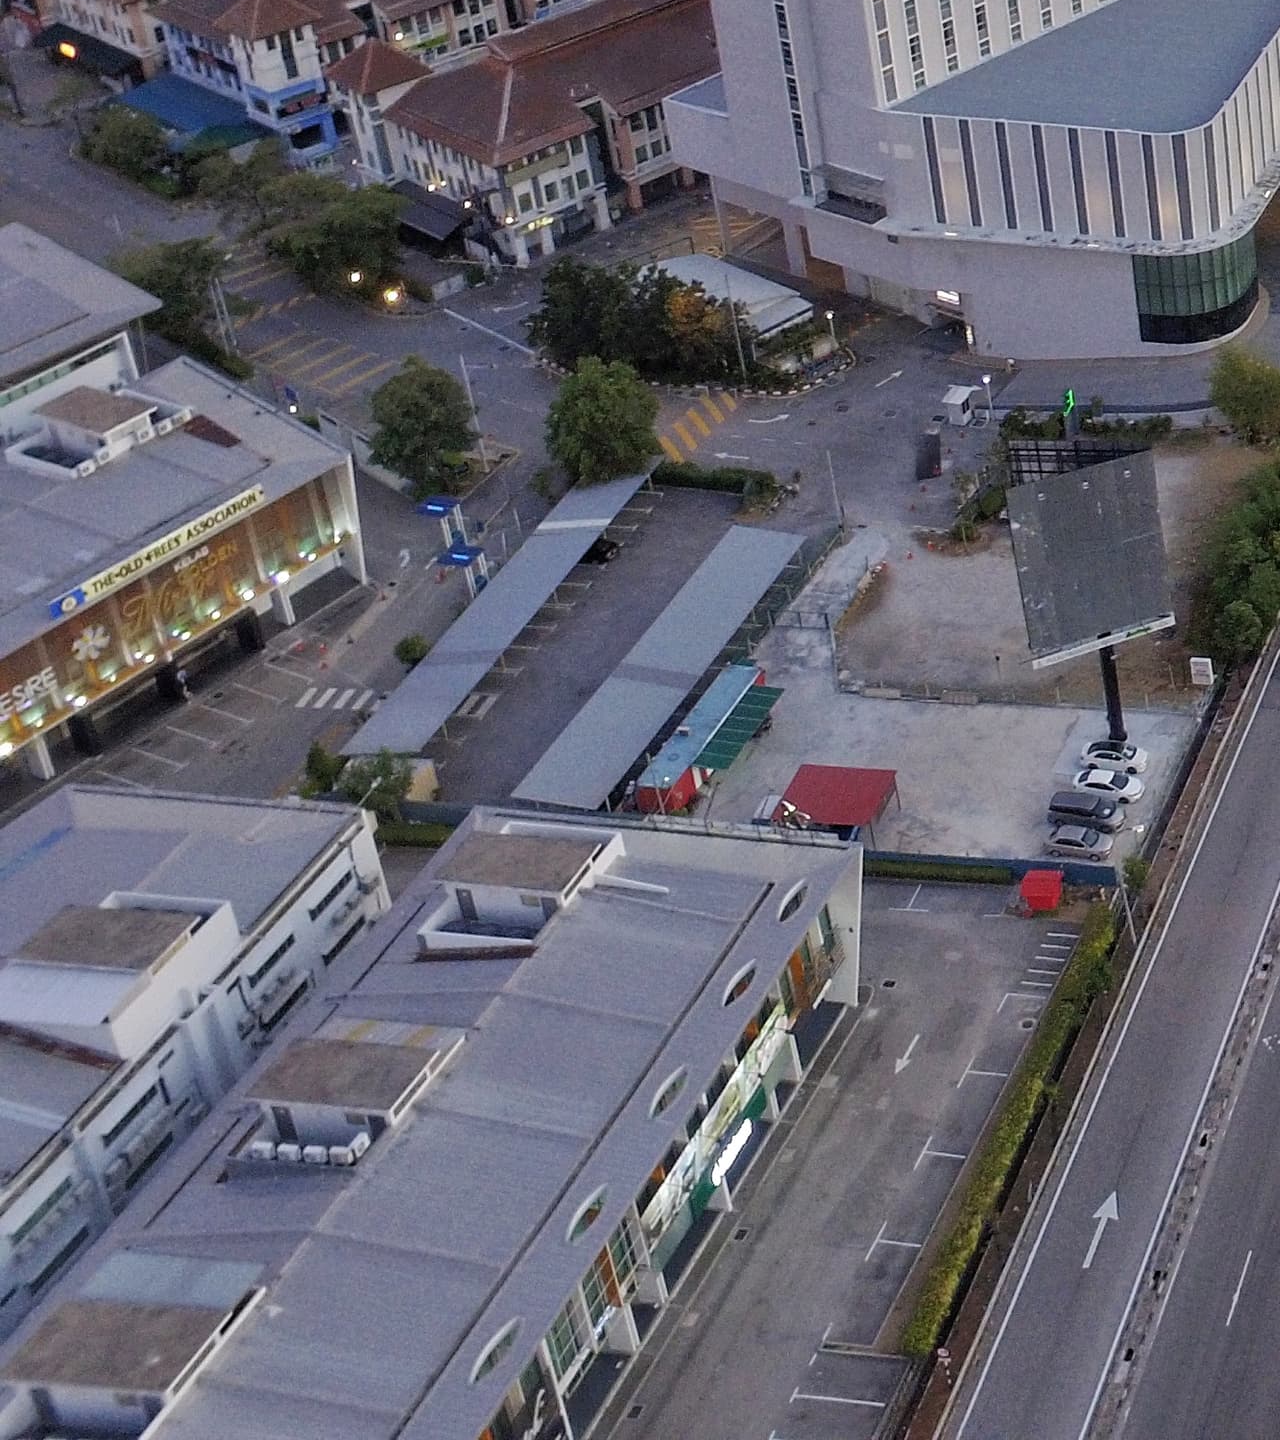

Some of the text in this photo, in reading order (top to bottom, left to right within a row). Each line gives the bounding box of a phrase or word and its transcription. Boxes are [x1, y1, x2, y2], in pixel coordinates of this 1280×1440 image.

[91, 572, 115, 593] THE
[119, 556, 144, 578] OLD
[186, 492, 257, 541] ASSOCIATION
